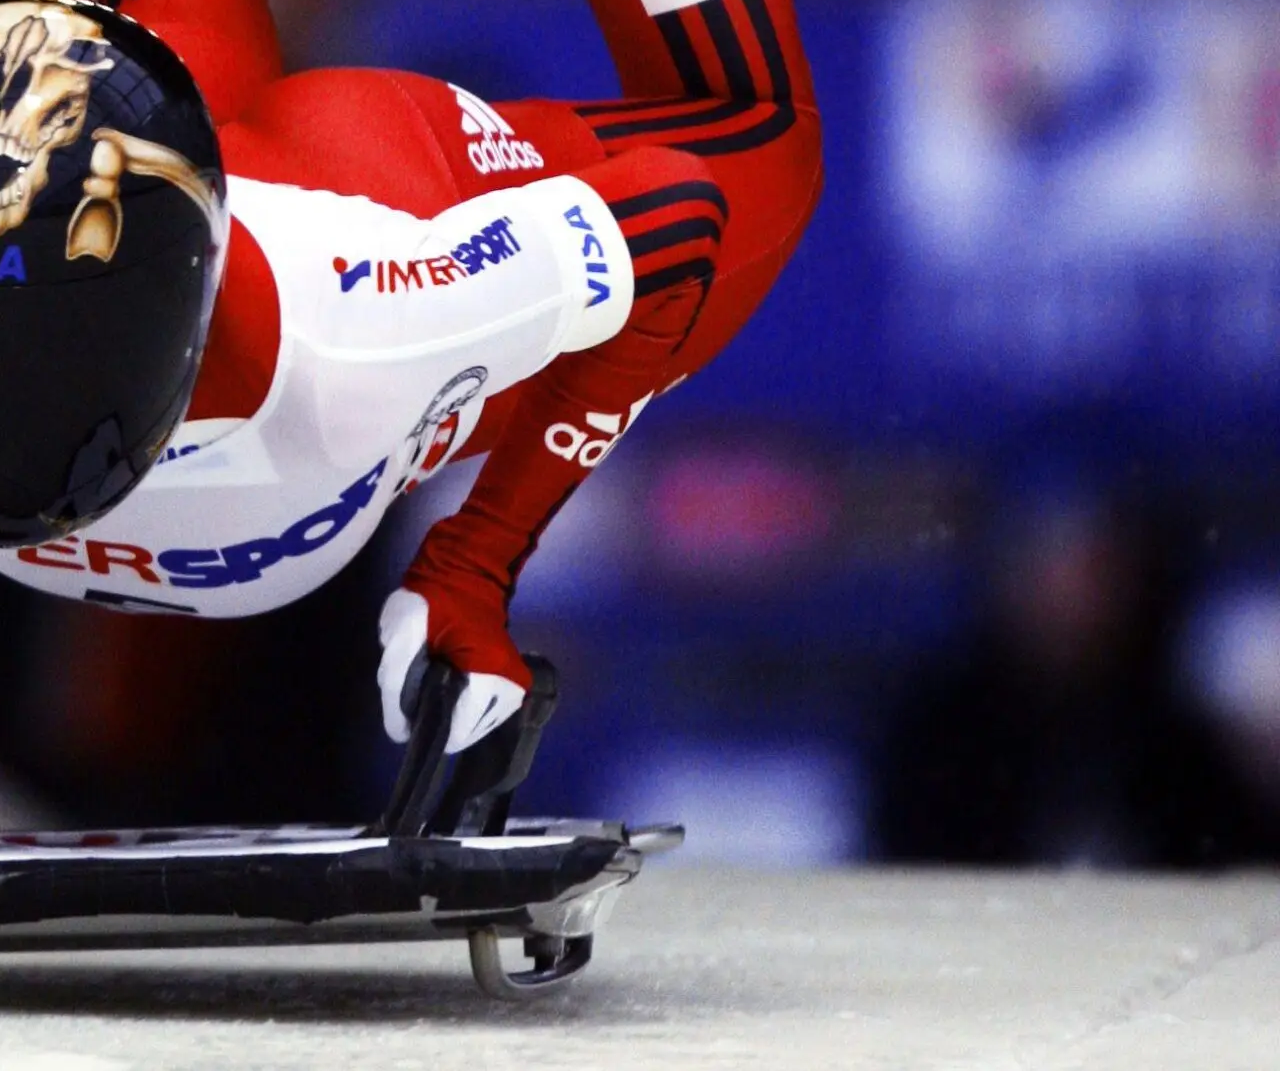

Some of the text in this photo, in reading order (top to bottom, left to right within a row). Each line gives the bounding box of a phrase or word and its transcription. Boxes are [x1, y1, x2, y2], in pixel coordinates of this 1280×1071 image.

[467, 130, 544, 174] adidas
[376, 217, 521, 293] INTERSPORT
[563, 205, 611, 307] VISA
[17, 457, 389, 589] ERSPOR
